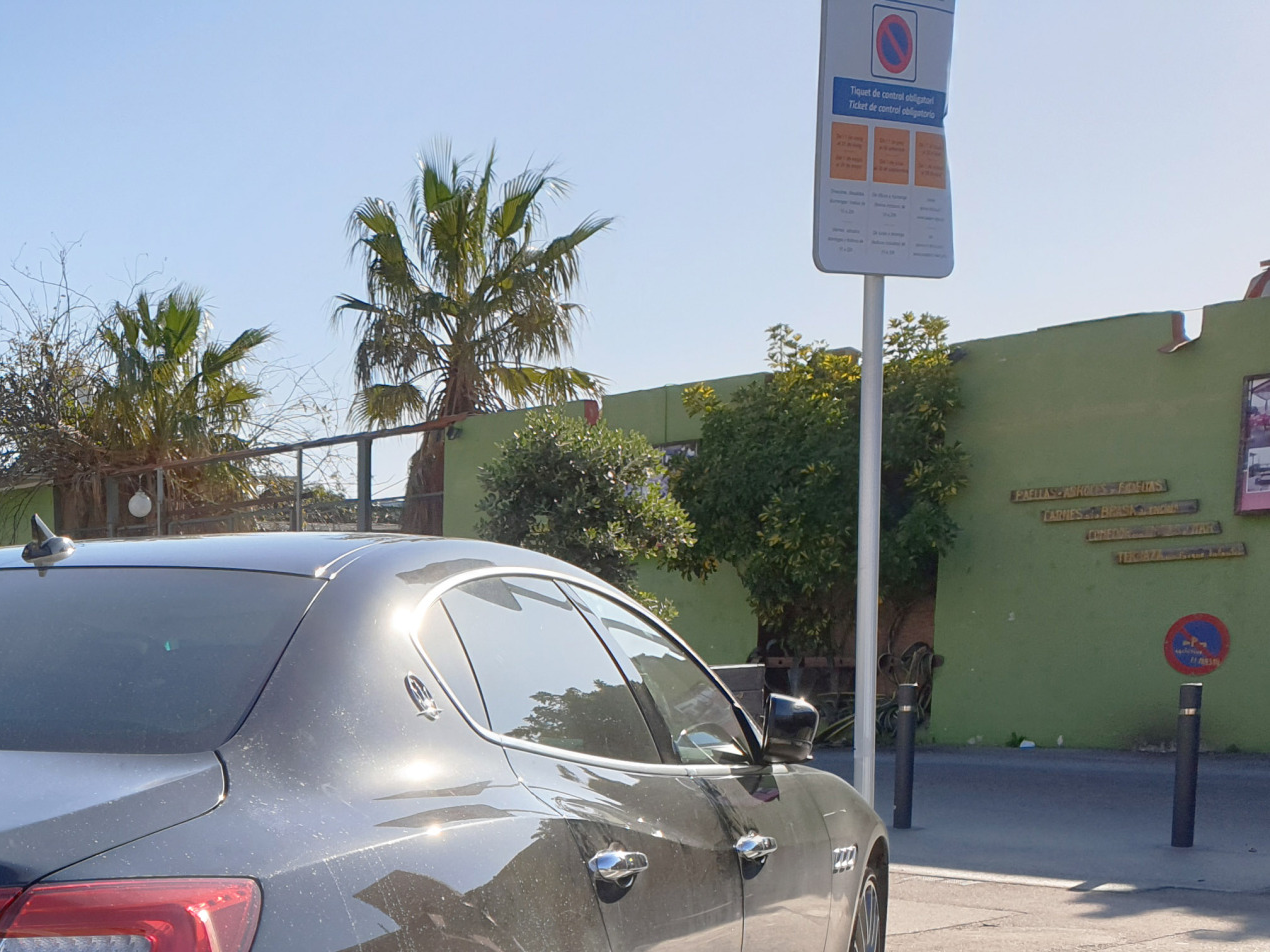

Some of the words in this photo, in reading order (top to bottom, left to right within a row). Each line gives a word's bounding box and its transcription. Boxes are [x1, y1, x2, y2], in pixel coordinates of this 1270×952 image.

[850, 86, 871, 97] Tiquet
[872, 88, 880, 98] de
[882, 90, 904, 100] control
[849, 100, 868, 110] Ticket
[869, 103, 877, 112] de
[878, 105, 901, 114] control
[902, 106, 935, 119] obligatorio
